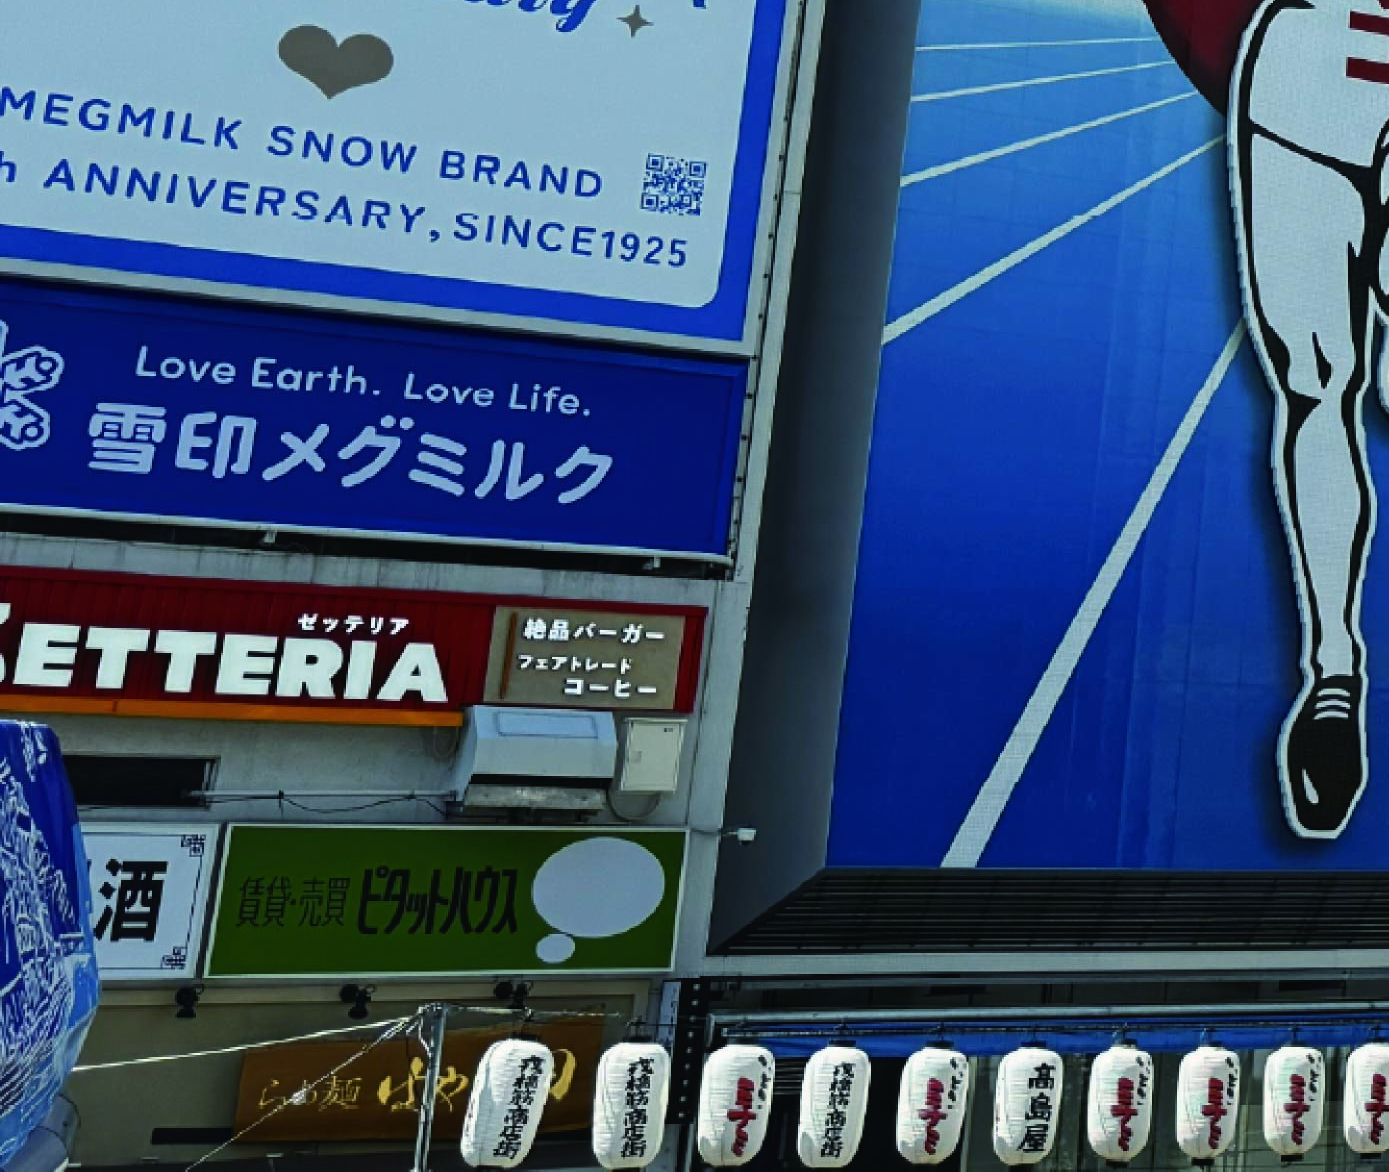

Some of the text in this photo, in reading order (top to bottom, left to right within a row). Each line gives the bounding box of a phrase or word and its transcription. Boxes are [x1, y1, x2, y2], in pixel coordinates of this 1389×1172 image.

[0, 86, 603, 200] MEGMILK SNOW BRAND
[135, 345, 591, 418] Love Earth. Love Life.
[88, 401, 613, 505] 雪印メグミルク
[298, 612, 409, 637] ゼッテリア
[523, 618, 665, 645] 絶品バーガー
[517, 654, 632, 675] フェアトレード
[563, 677, 658, 698] コーヒー
[93, 859, 168, 941] 酒
[357, 866, 518, 935] ピタットハウス
[491, 1054, 546, 1160] 戎橋筋商店街
[621, 1056, 655, 1159] 戎橋筋商店街
[820, 1059, 855, 1159] 戎橋筋商店街
